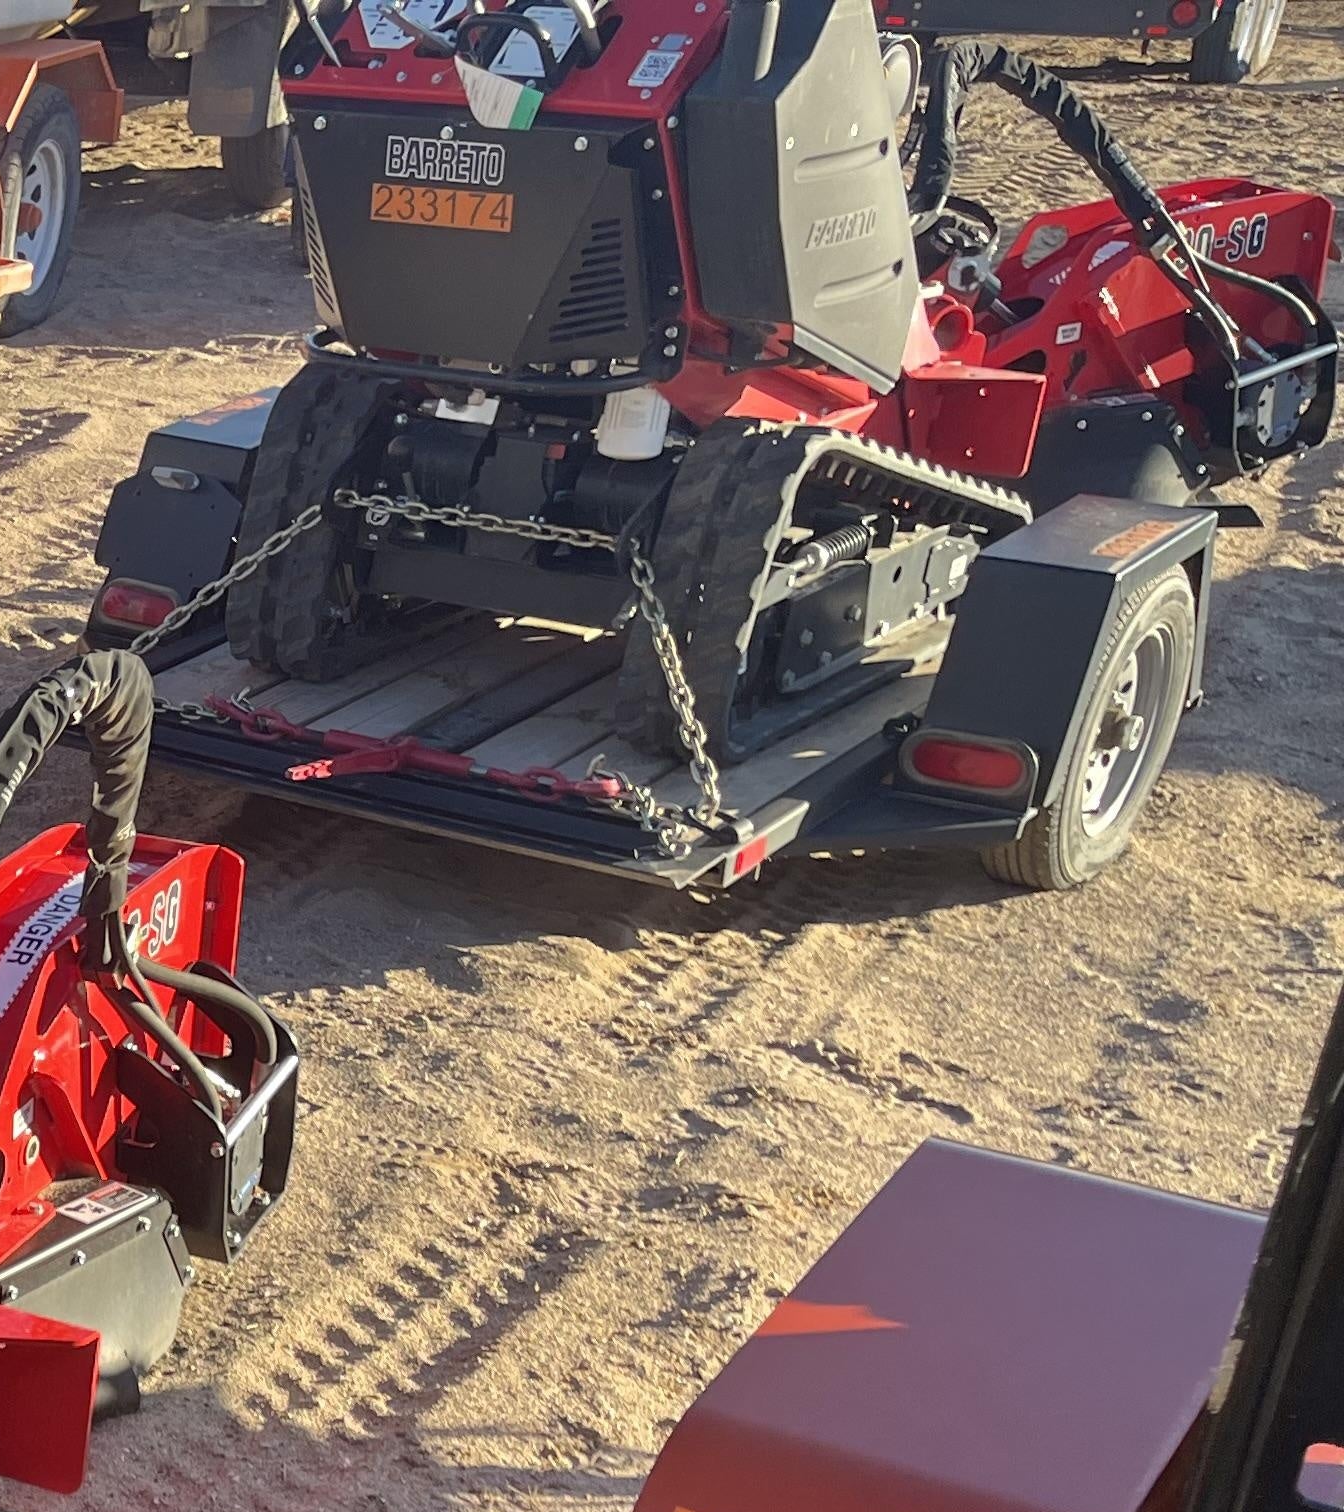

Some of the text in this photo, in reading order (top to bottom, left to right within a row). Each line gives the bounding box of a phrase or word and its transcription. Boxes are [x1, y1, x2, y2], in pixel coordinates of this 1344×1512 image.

[384, 135, 506, 185] BARRETO
[372, 185, 511, 229] 233174
[804, 207, 877, 250] BARRETO
[1185, 212, 1268, 262] 0-SG
[6, 893, 80, 966] DANGER
